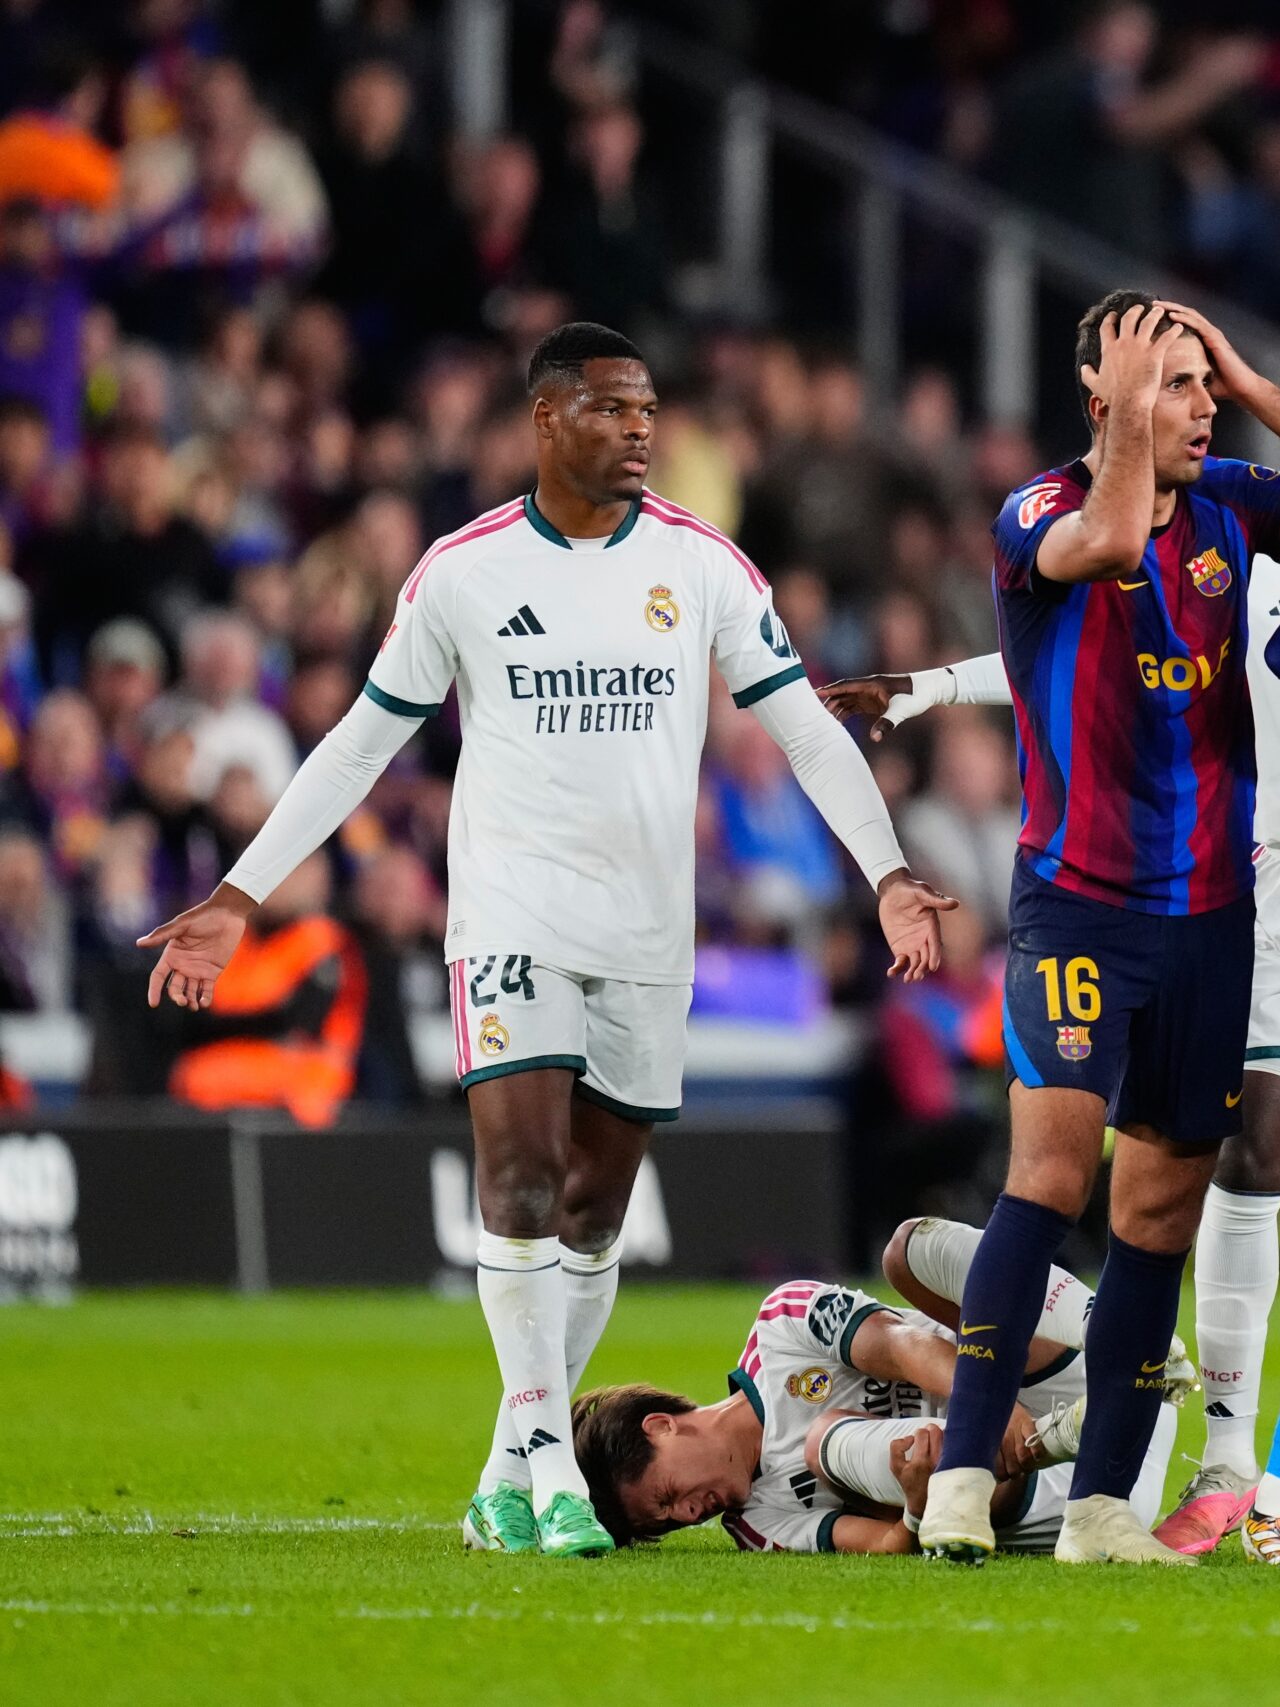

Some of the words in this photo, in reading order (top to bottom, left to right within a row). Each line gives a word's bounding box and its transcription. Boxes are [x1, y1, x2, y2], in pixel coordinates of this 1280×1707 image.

[505, 660, 675, 700] Emirates
[536, 704, 571, 734] FLY
[579, 702, 654, 732] BETTER
[469, 955, 535, 1008] 24
[1035, 956, 1102, 1022] 16
[1201, 1365, 1243, 1383] MCF
